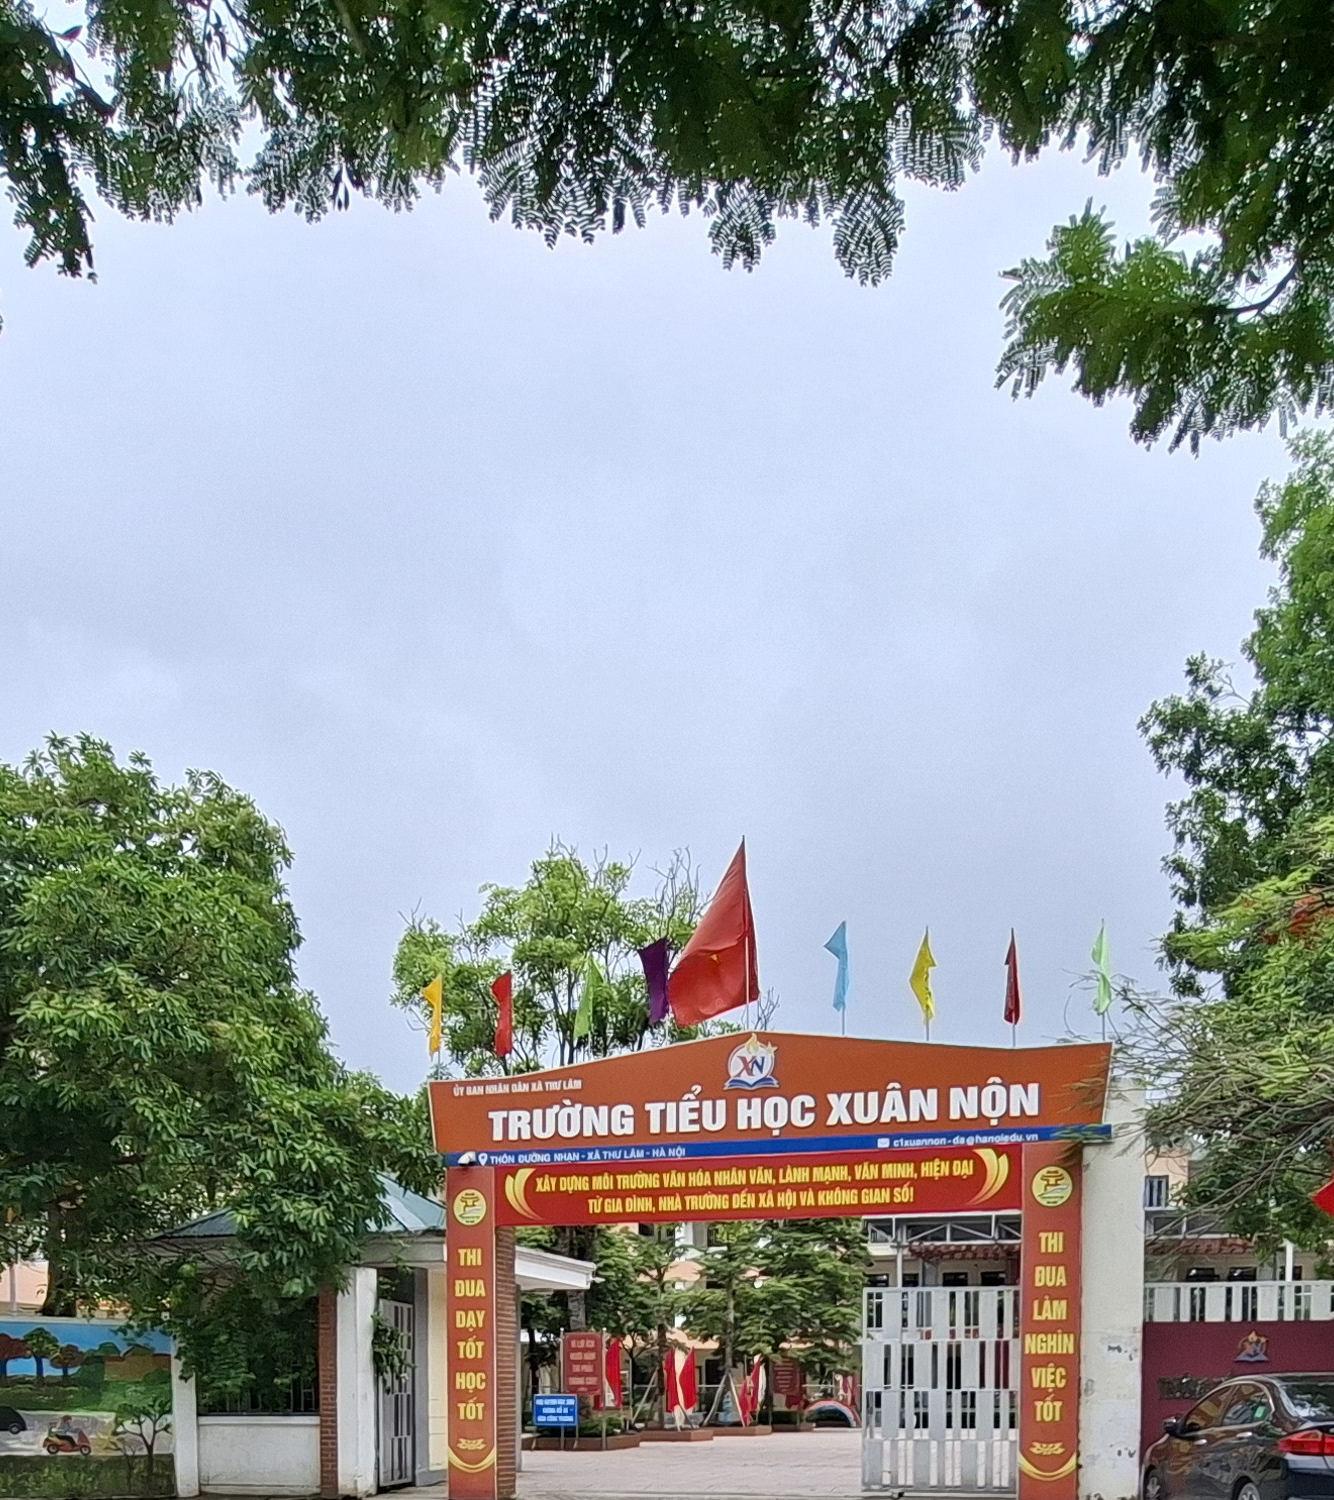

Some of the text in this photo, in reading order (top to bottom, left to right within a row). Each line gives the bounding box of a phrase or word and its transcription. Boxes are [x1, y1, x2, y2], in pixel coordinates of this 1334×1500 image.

[733, 1055, 766, 1078] XN
[466, 1085, 484, 1096] BAN
[485, 1083, 509, 1095] NHÂN
[511, 1081, 529, 1093] DÂN
[531, 1080, 544, 1092] XÃ
[563, 1078, 582, 1090] LÂM
[488, 1077, 1039, 1141] TRƯỜNG TIỂU HỌC XUÂN NỘN
[489, 1154, 515, 1165] THÔN
[553, 1152, 580, 1164] NHẠN
[587, 1150, 601, 1161] XÃ
[602, 1149, 622, 1160] THƯ
[624, 1148, 644, 1159] LÂM
[652, 1147, 666, 1158] HÀ
[668, 1146, 686, 1159] NỘI
[535, 1158, 974, 1194] XÂY DỰNG MÔI TRƯỜNG VĂN HÓA NHÂN VĂN, LÀNH MẠNH, VĂN MINH, HIỆN ĐẠI
[587, 1195, 603, 1214] TỪ
[604, 1198, 623, 1213] GIA
[625, 1194, 656, 1213] ĐÌNH,
[658, 1193, 682, 1212] NHÀ
[684, 1191, 729, 1211] TRƯỜNG
[732, 1187, 756, 1209] ĐẾN
[758, 1188, 774, 1208] XÃ
[777, 1187, 797, 1210] HỘI
[799, 1187, 816, 1206] VÀ
[818, 1186, 858, 1206] KHÔNG
[861, 1186, 891, 1204] GIAN
[1038, 1232, 1064, 1253] THI
[458, 1248, 482, 1266] THI
[455, 1279, 486, 1297] ĐUA
[1034, 1266, 1067, 1287] ĐUA
[1033, 1295, 1067, 1320] LÀM
[455, 1310, 486, 1332] DẠY
[457, 1335, 485, 1359] TỐT
[1024, 1329, 1075, 1354] NGHÌN
[455, 1372, 486, 1393] HỌC
[1031, 1362, 1067, 1393] VIỆC
[457, 1396, 485, 1420] TỐT
[1034, 1393, 1063, 1422] TỐT
